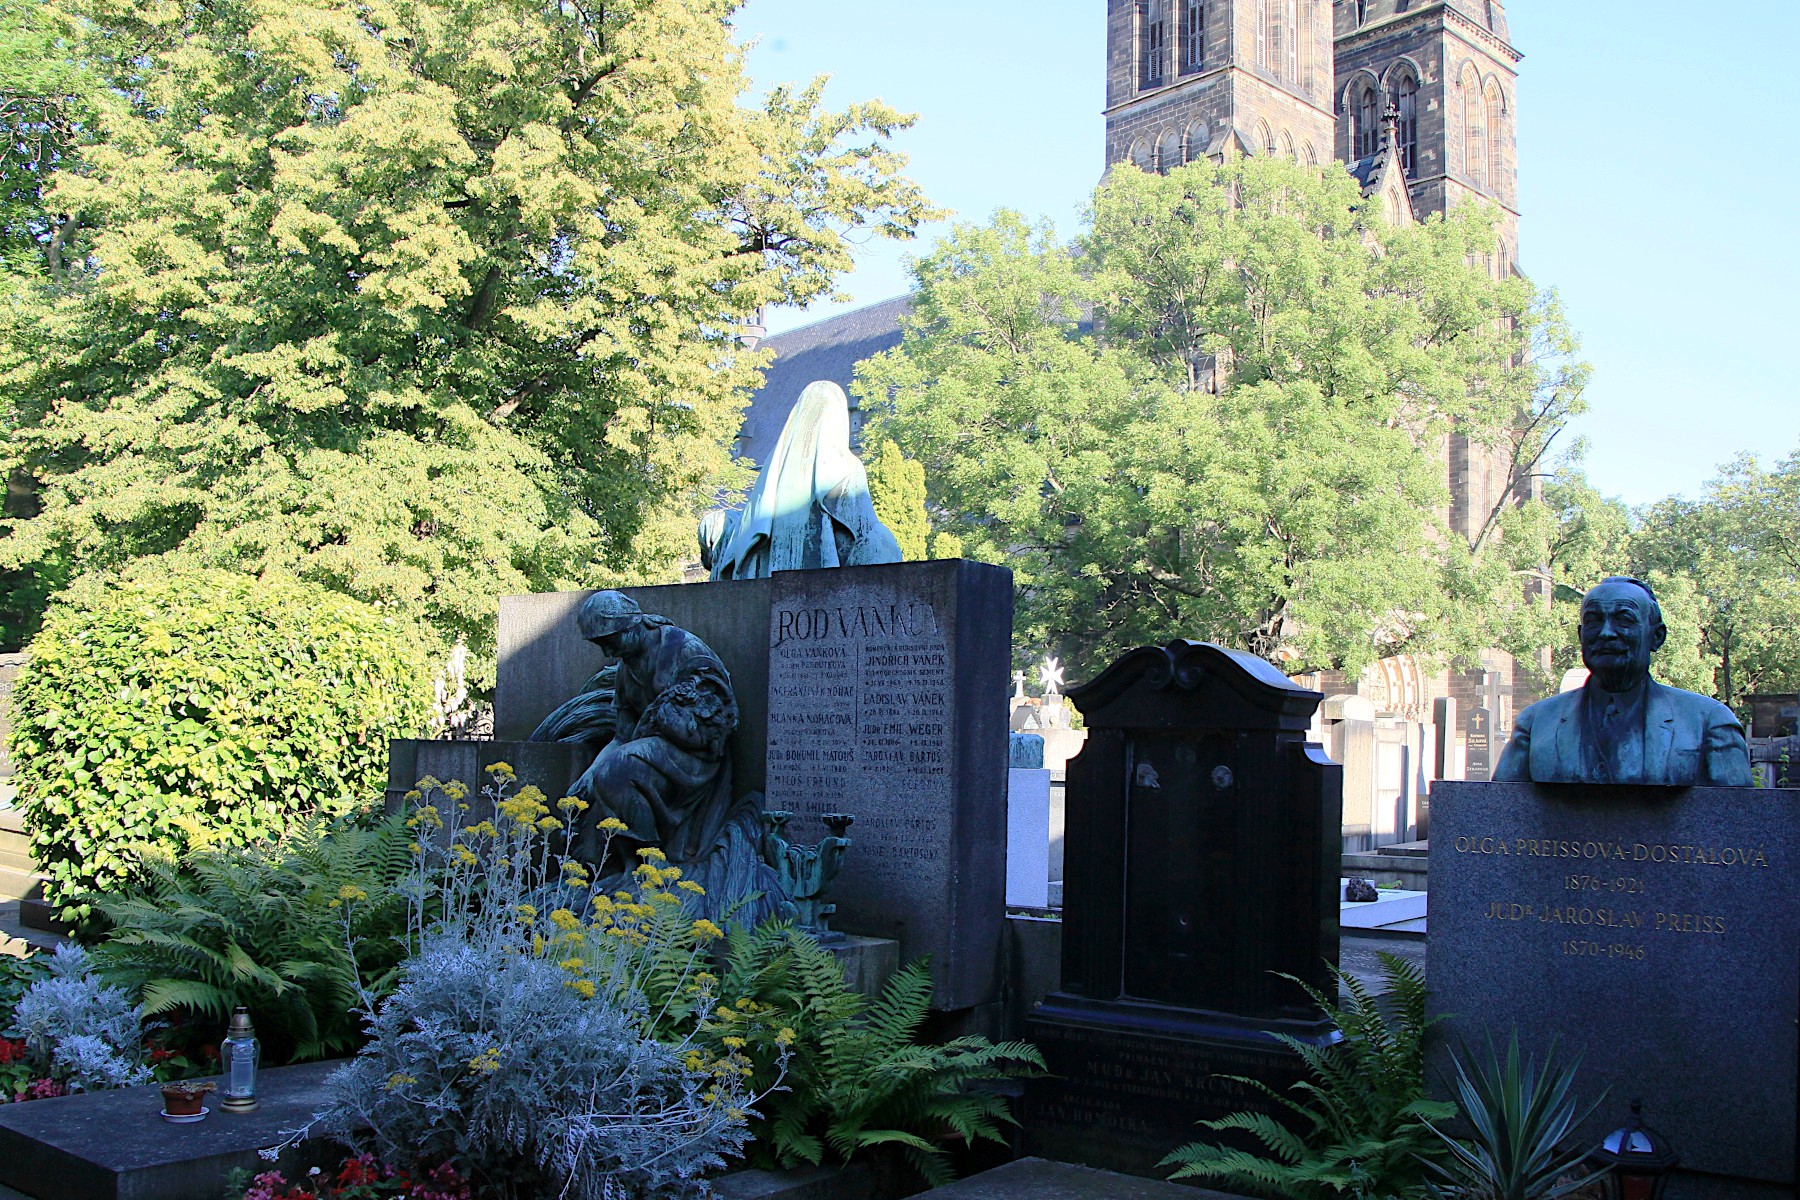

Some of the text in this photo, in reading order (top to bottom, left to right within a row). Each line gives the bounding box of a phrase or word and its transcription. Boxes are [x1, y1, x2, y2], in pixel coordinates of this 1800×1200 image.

[774, 608, 830, 645] ROD
[786, 749, 820, 761] BOHUMIL
[1454, 836, 1769, 867] OLGA PREISSOVÁ-DOSTALOVÁ
[1563, 873, 1646, 895] 1876-1921
[1538, 905, 1646, 929] JAROSLAV
[1655, 912, 1727, 934] PREISS
[1562, 939, 1646, 961] 1870-1946
